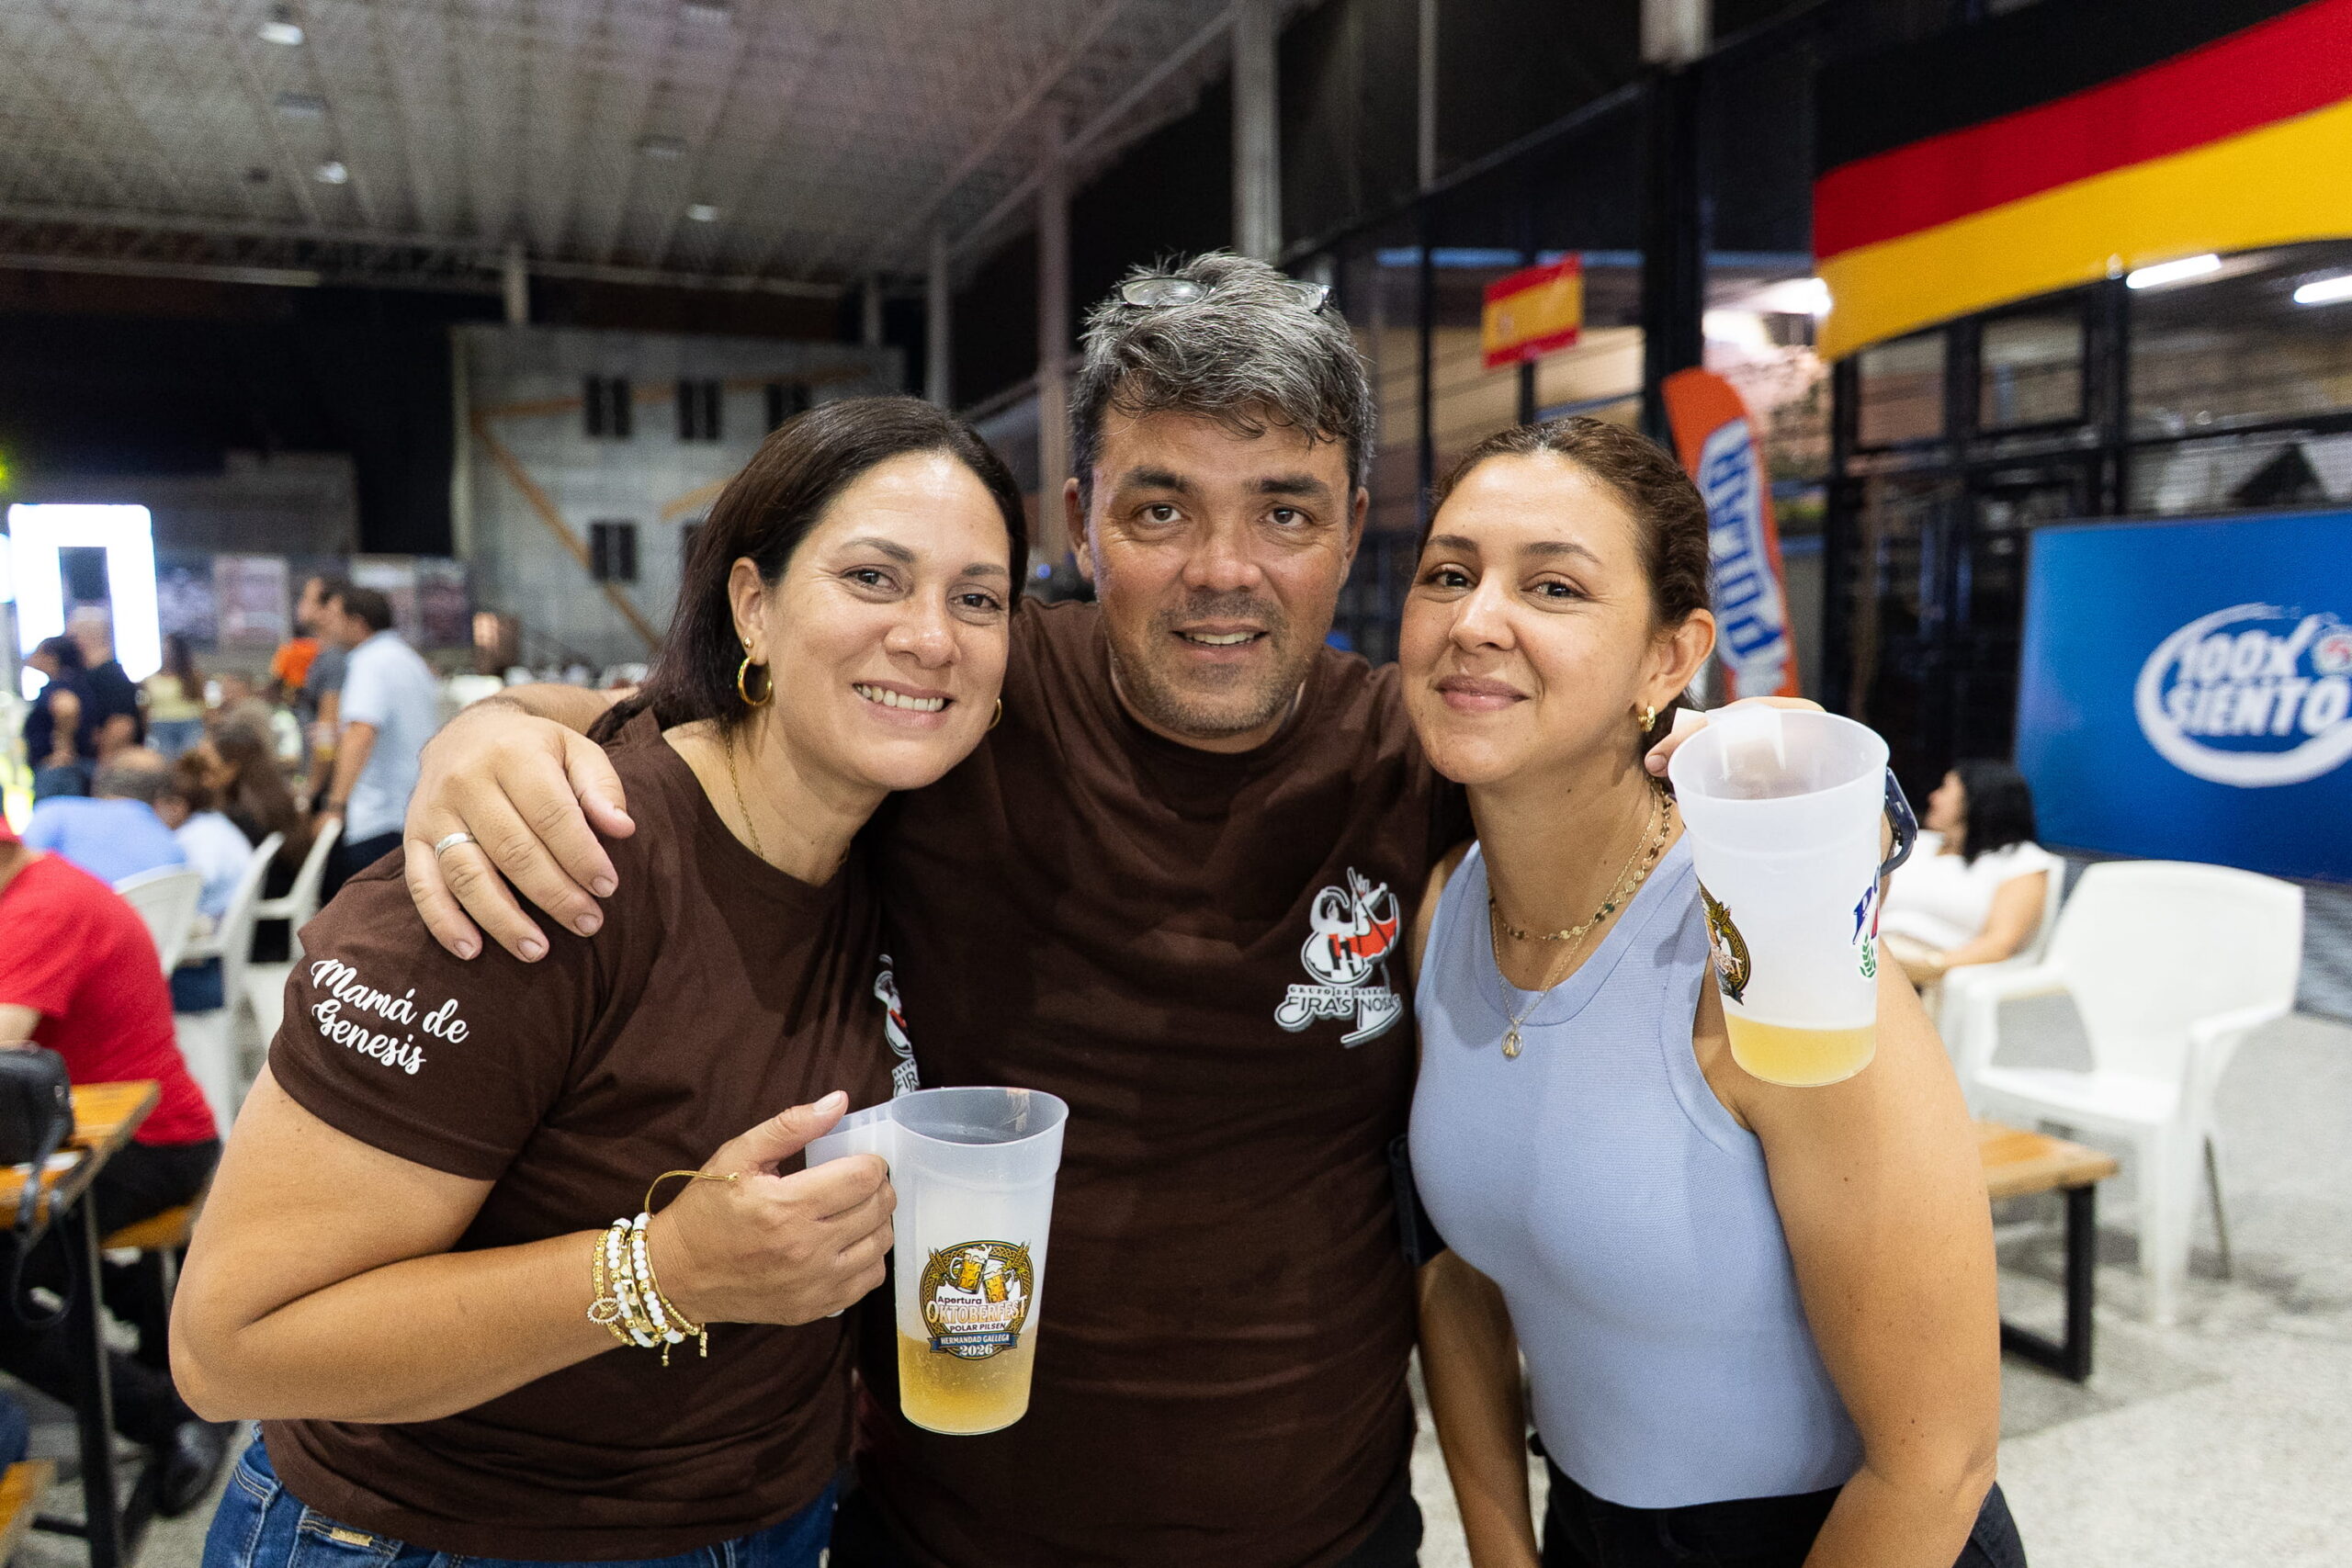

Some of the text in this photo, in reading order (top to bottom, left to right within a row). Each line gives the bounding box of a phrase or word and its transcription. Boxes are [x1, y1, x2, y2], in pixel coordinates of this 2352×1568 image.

[2166, 674, 2350, 735] SIENTO
[311, 958, 469, 1043] Mamá de
[311, 998, 427, 1075] Genesis
[926, 1295, 1028, 1325] OKTOBERFEST
[937, 1295, 982, 1306] Apertura
[950, 1323, 1006, 1332] POLAR PILSEN
[941, 1334, 1010, 1345] HERMANDAD GALLEGA
[959, 1344, 994, 1357] 2026
